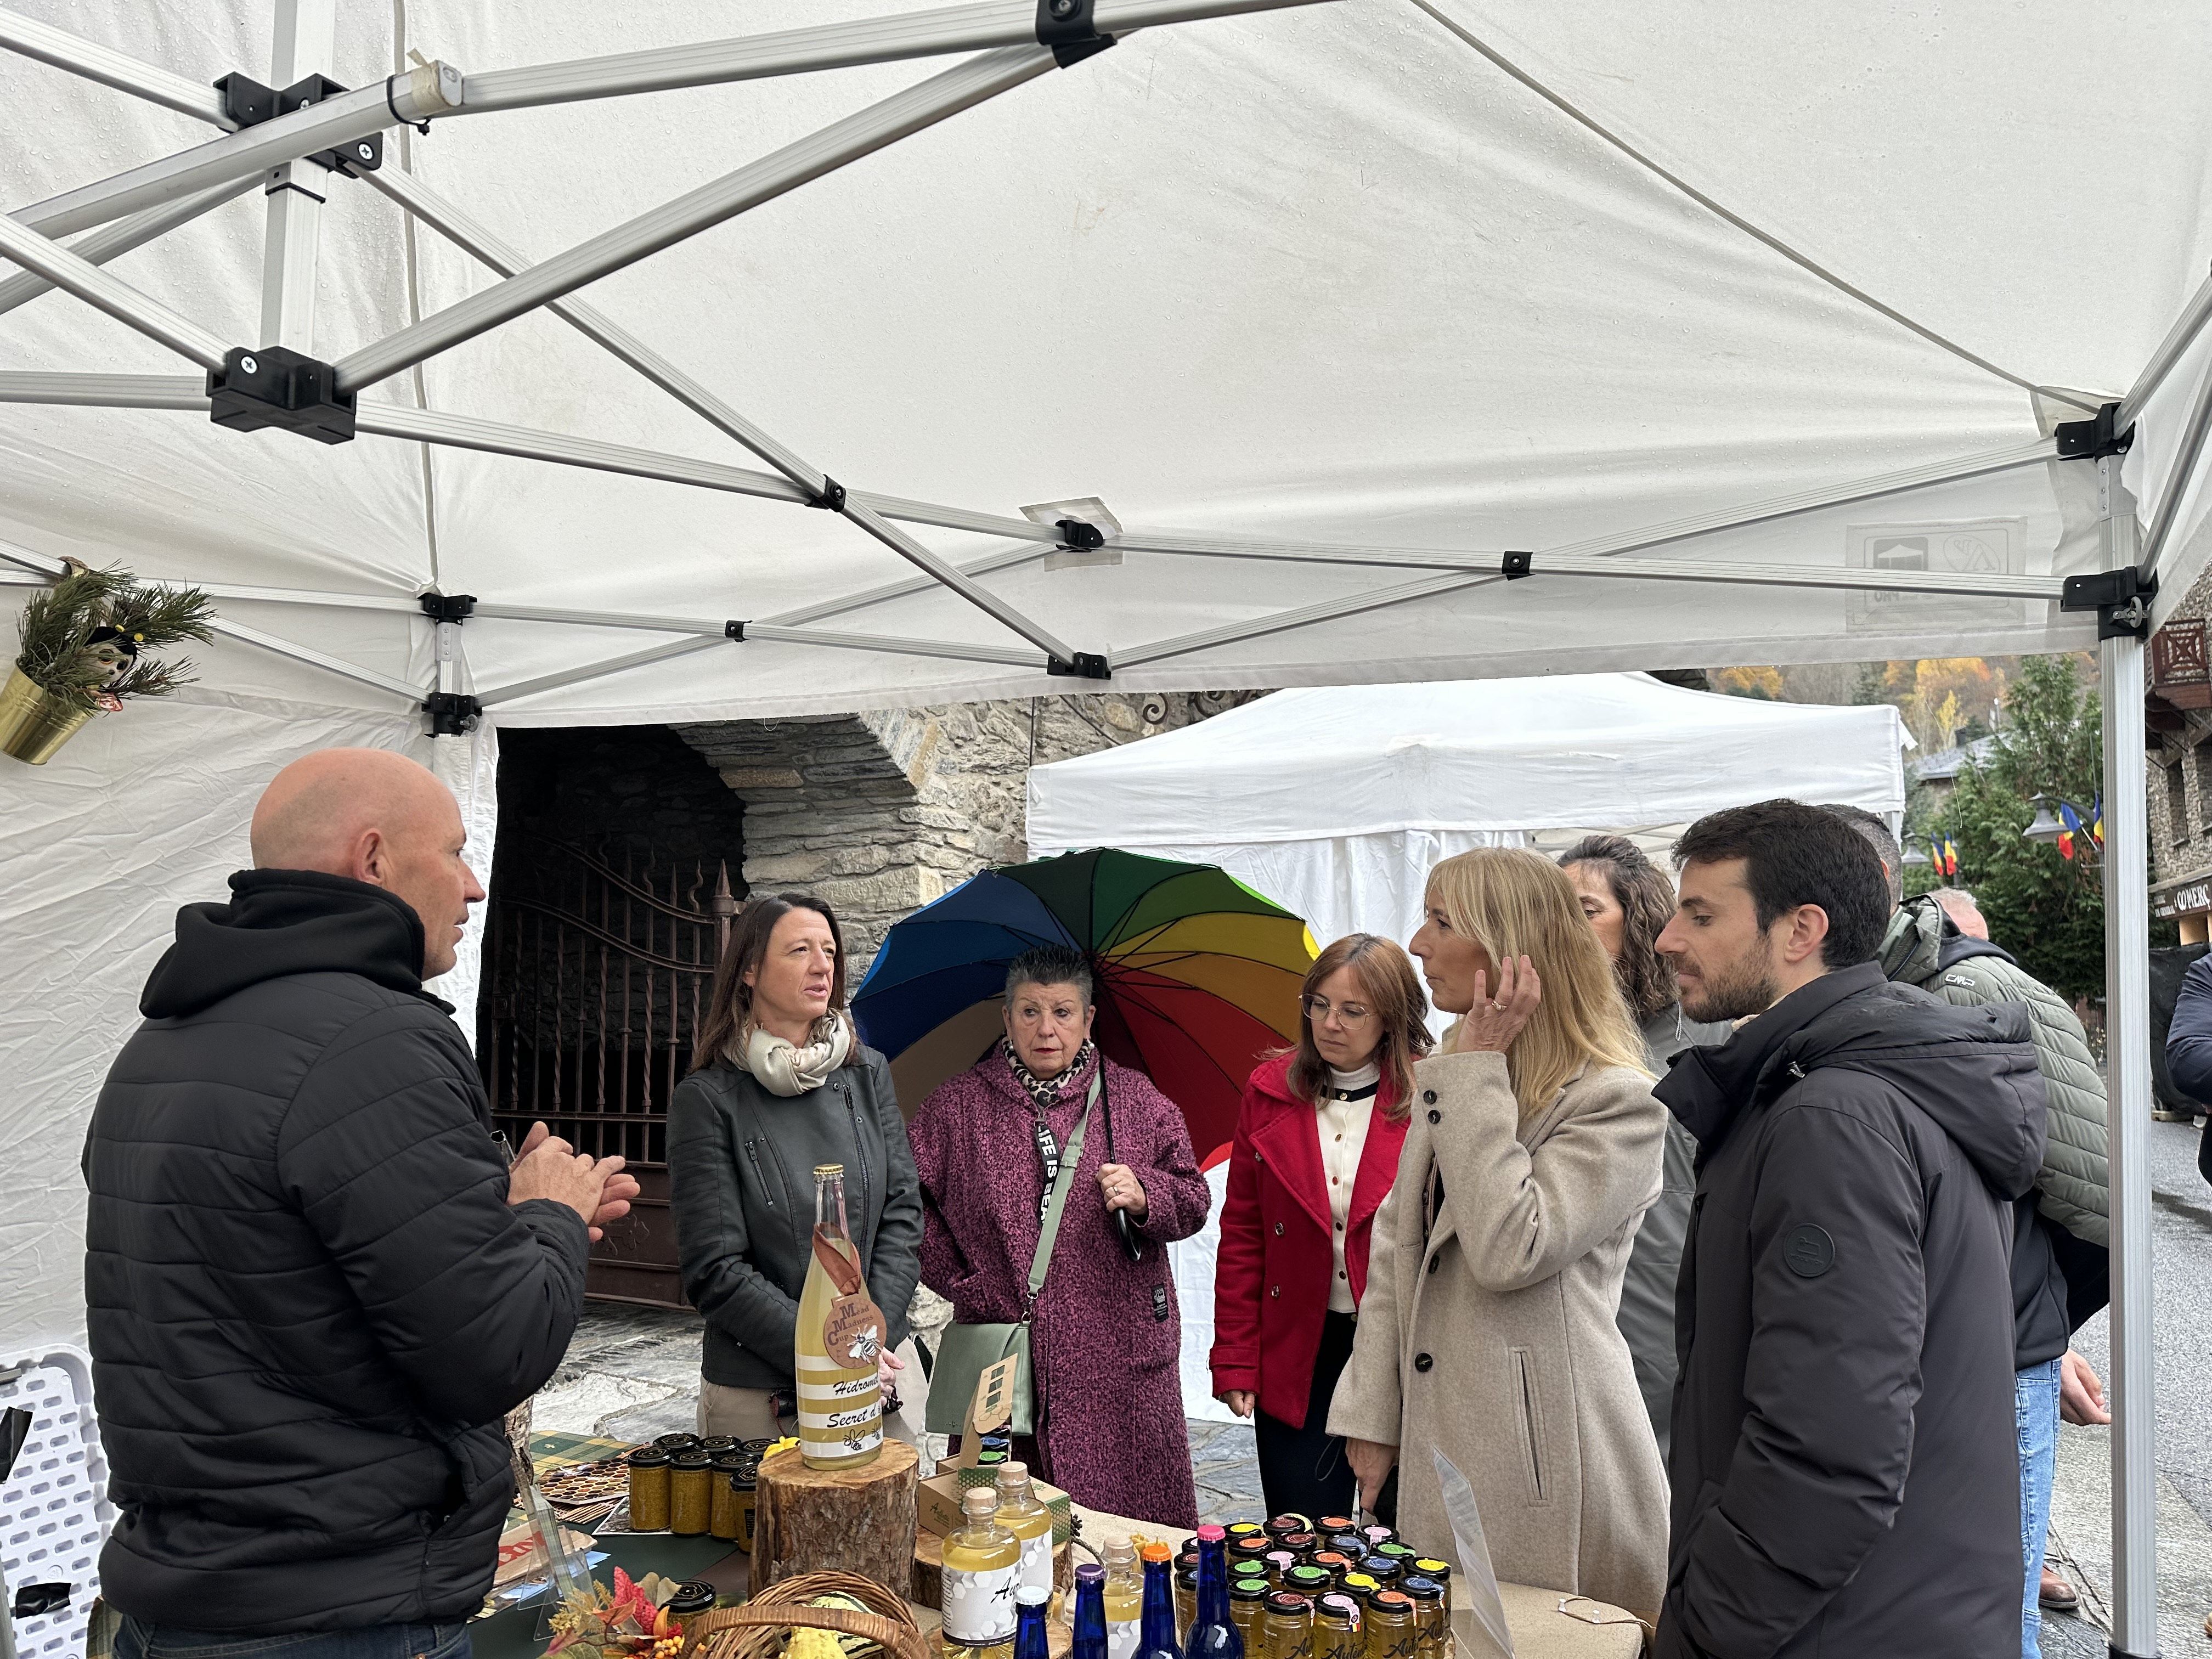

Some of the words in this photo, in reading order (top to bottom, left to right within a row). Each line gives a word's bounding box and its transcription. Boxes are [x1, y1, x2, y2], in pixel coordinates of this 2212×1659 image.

[2177, 883, 2210, 911] COMERÇ
[1945, 974, 1976, 986] CMP
[1046, 1159, 1058, 1178] IS
[839, 1302, 870, 1319] Mead
[832, 1314, 873, 1333] Madness
[827, 1331, 849, 1346] Cup
[827, 1408, 867, 1428] Secret
